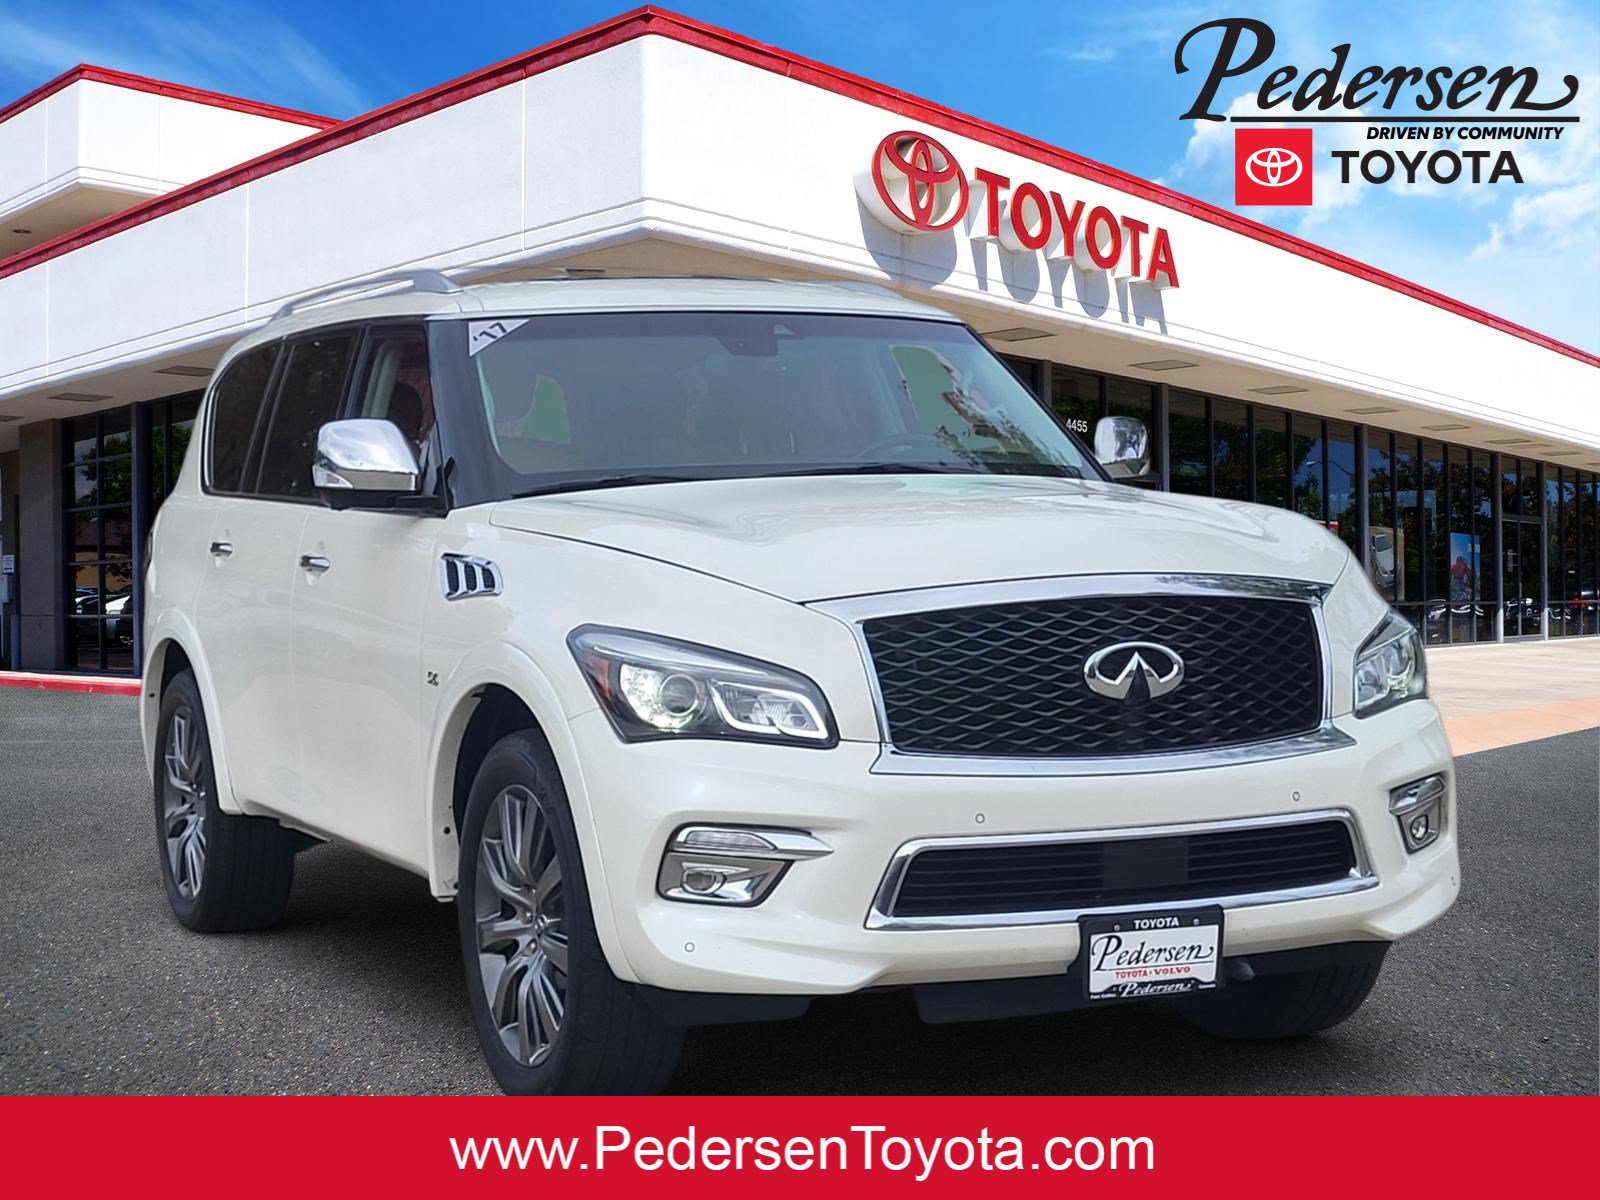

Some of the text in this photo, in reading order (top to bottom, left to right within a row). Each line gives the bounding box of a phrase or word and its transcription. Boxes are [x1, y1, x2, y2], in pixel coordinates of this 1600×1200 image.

[974, 167, 1179, 288] TOYOTA
[1065, 418, 1088, 433] 4455
[1133, 917, 1180, 930] TOYOTA
[1091, 934, 1214, 972] Pedersen
[1115, 966, 1191, 979] TOYOTA VOLVO
[1118, 981, 1192, 998] Pedersen
